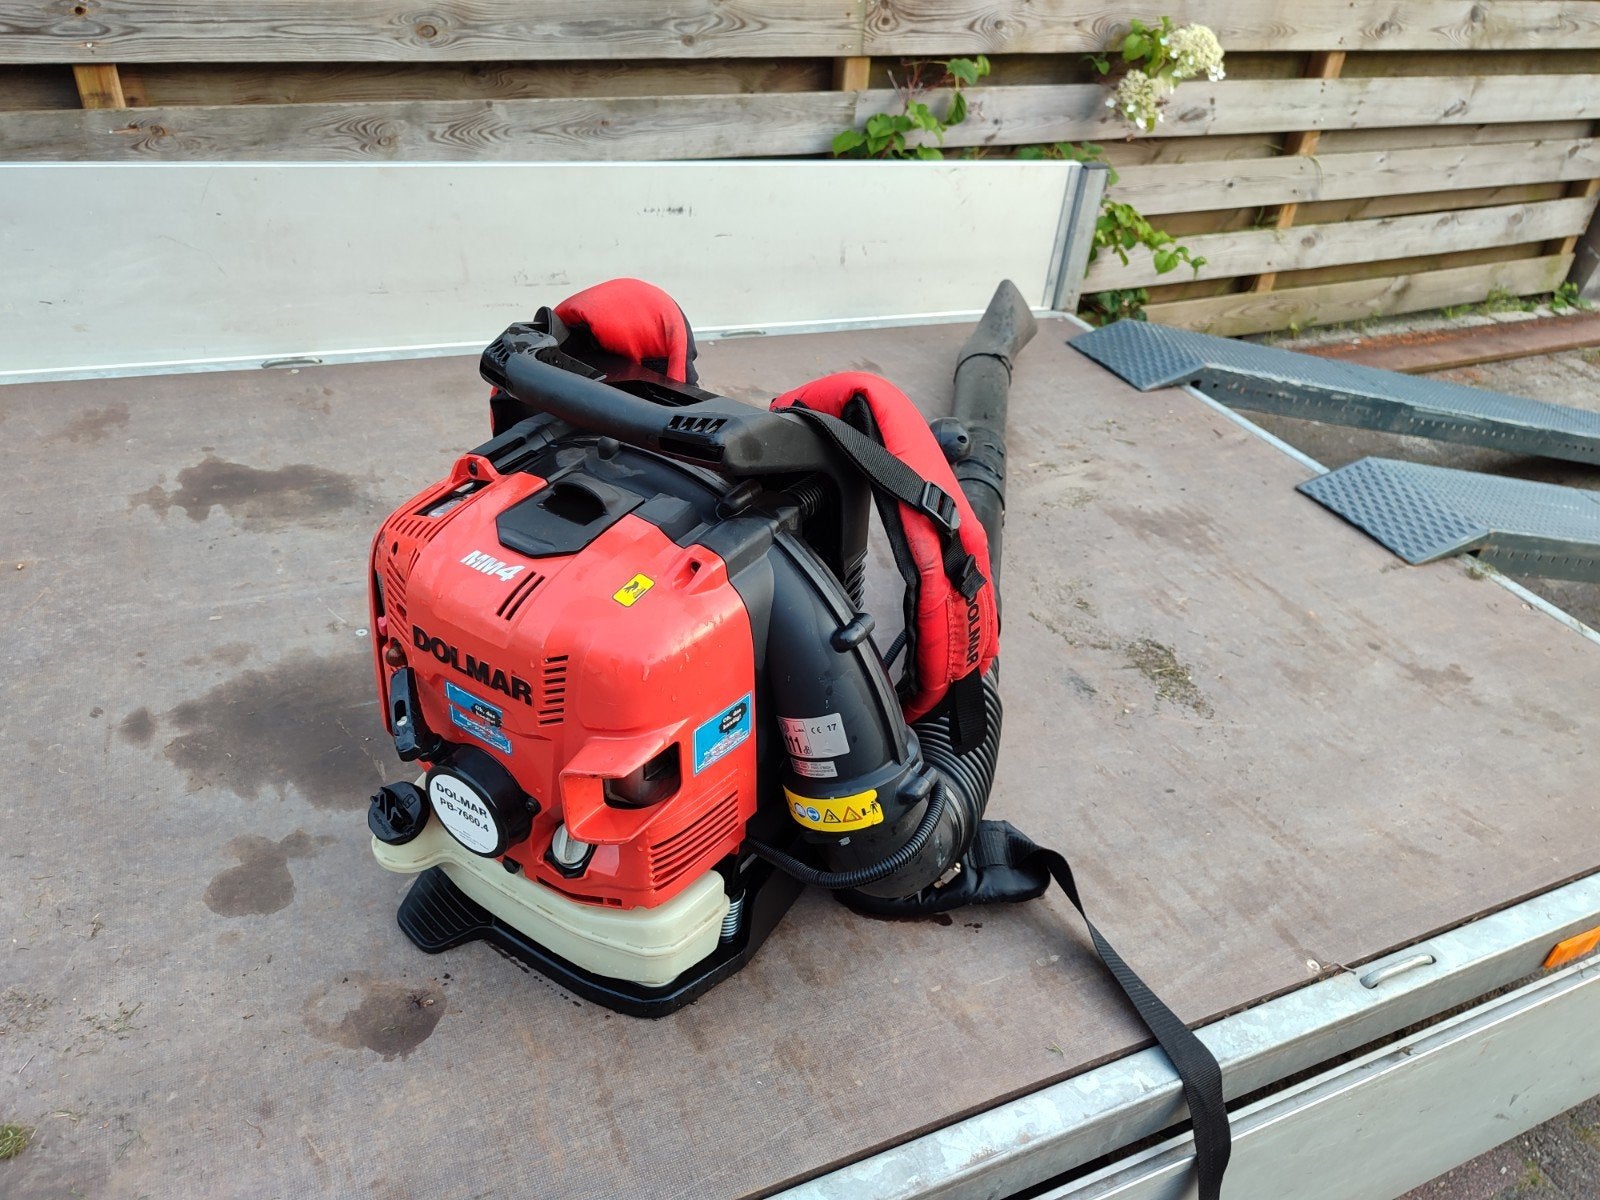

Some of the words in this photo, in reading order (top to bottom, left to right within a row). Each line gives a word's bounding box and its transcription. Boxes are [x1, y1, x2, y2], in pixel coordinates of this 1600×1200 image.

[459, 549, 526, 582] MM4
[412, 623, 533, 707] DOLMAR
[826, 722, 838, 732] 17
[436, 781, 488, 819] DOLMAR
[439, 796, 490, 833] PB-7660.4
